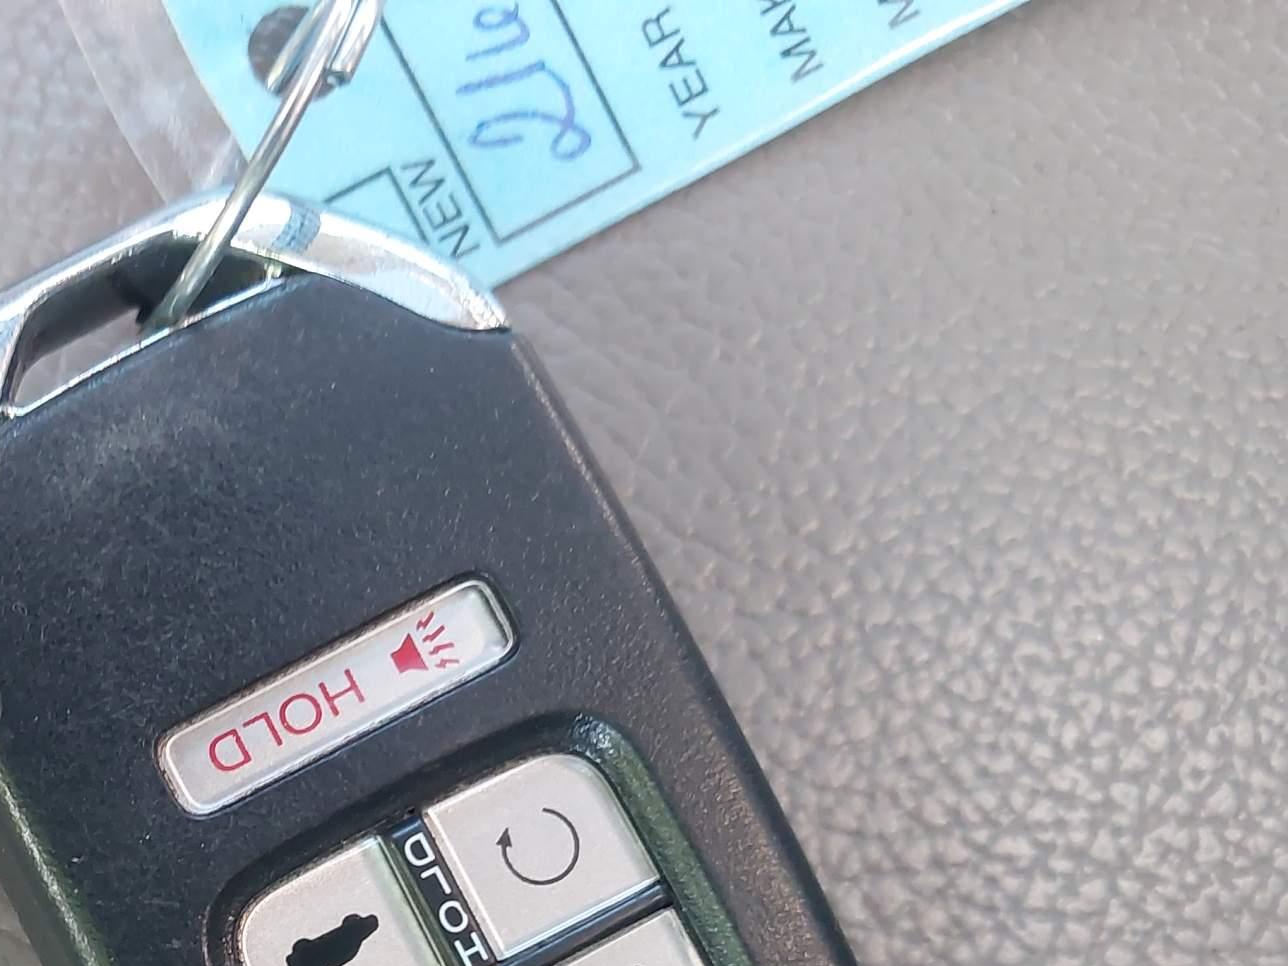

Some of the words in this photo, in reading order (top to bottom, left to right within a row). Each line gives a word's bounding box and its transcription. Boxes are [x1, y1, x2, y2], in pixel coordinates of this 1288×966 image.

[641, 6, 720, 140] YEAR
[399, 158, 481, 260] NEW
[208, 668, 366, 772] HOLD
